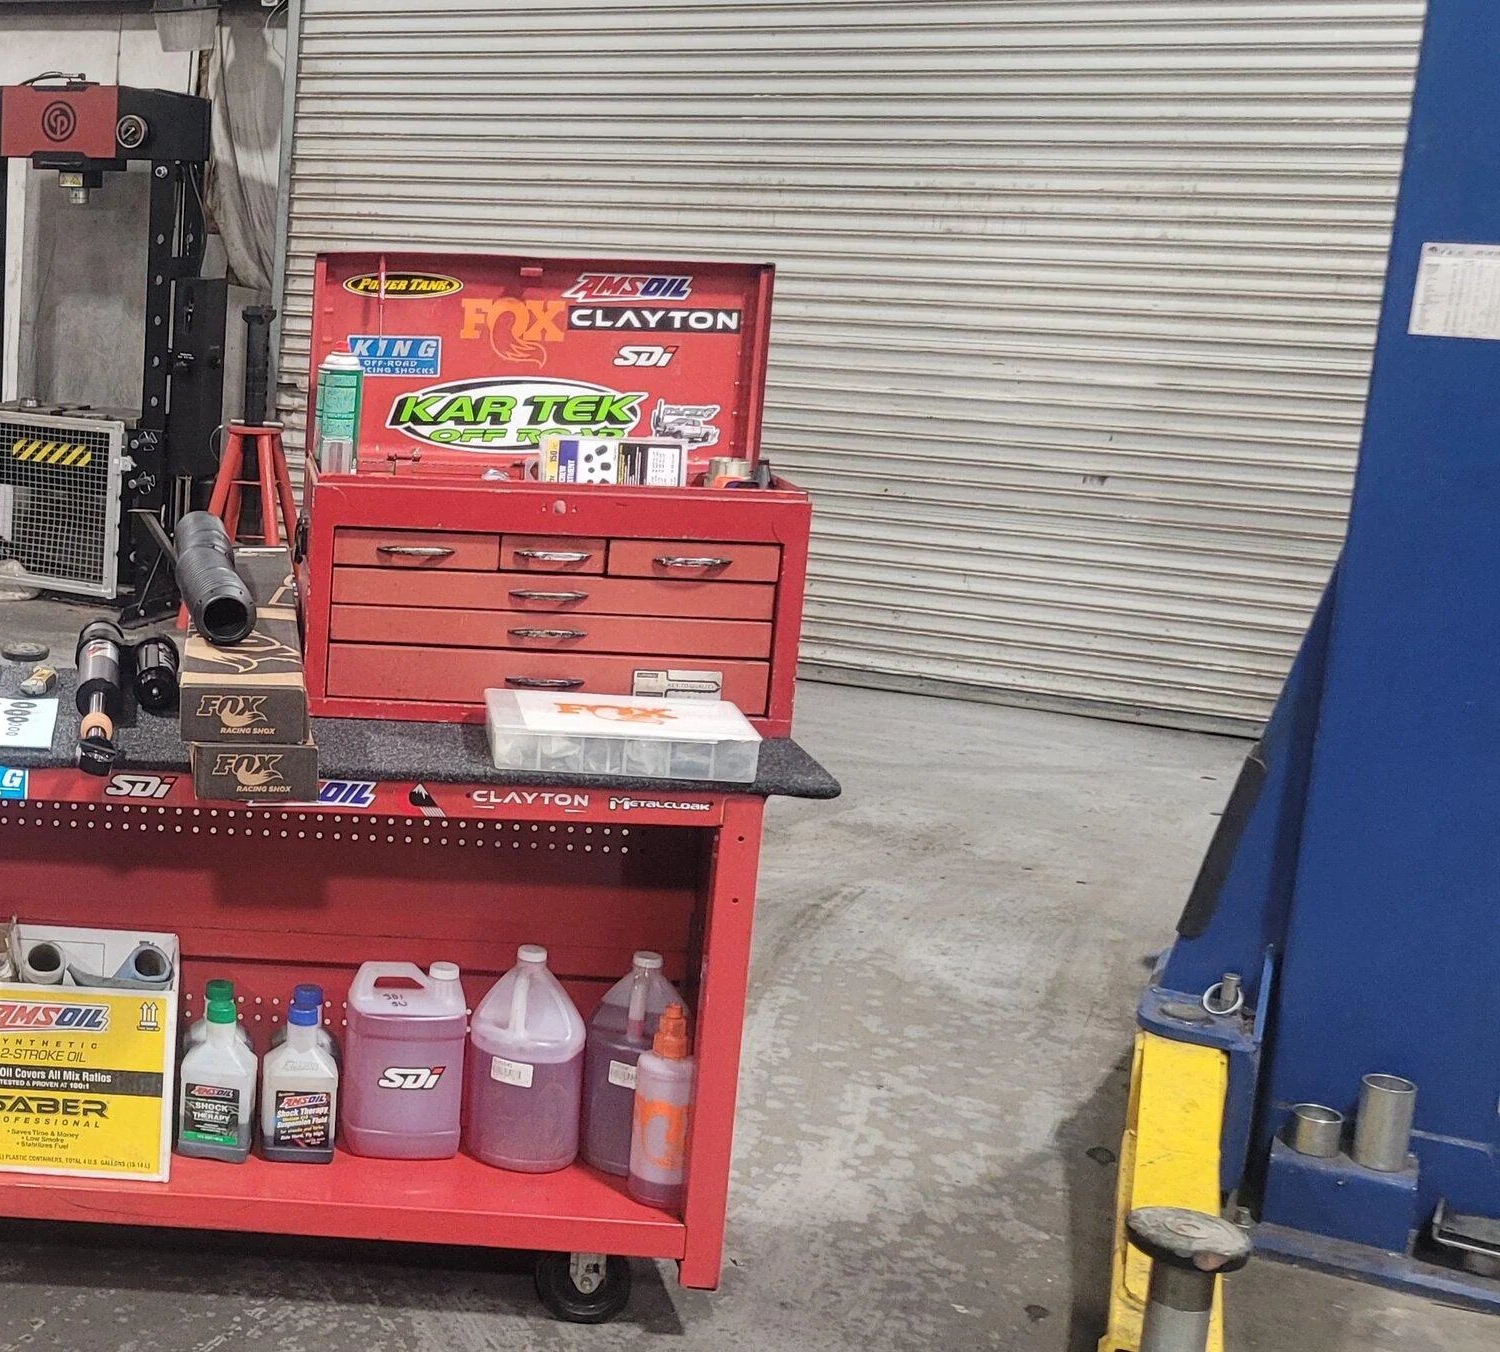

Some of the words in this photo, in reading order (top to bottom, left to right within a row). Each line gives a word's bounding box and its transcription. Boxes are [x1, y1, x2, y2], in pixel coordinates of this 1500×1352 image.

[566, 275, 690, 301] AMSOIL
[460, 297, 566, 355] FOX
[571, 309, 738, 330] CLAYTON
[353, 340, 437, 357] KING
[395, 367, 435, 375] SHOCKS
[397, 395, 517, 425] KAR
[528, 394, 645, 424] TEK
[429, 428, 508, 443] OFF
[196, 695, 268, 724] FOX
[554, 703, 679, 722] FOX
[220, 727, 251, 735] RACING
[212, 754, 284, 782] FOX
[236, 785, 267, 793] RACING
[472, 790, 589, 807] CLAYTON
[0, 1048, 65, 1061] 2-STROKE
[67, 1050, 86, 1063] OIL
[0, 1067, 13, 1078] Oil
[15, 1068, 46, 1079] Covers
[48, 1069, 61, 1080] All
[63, 1070, 80, 1081] Mix
[82, 1071, 112, 1083] Ratios
[191, 1086, 233, 1098] AMSOIL
[195, 1101, 228, 1112] SHOCK
[280, 1094, 327, 1109] AMSOIL
[277, 1109, 300, 1118] Shock
[300, 1107, 329, 1116] Therapy
[56, 1131, 79, 1139] Money
[5, 1153, 28, 1161] PLASTIC
